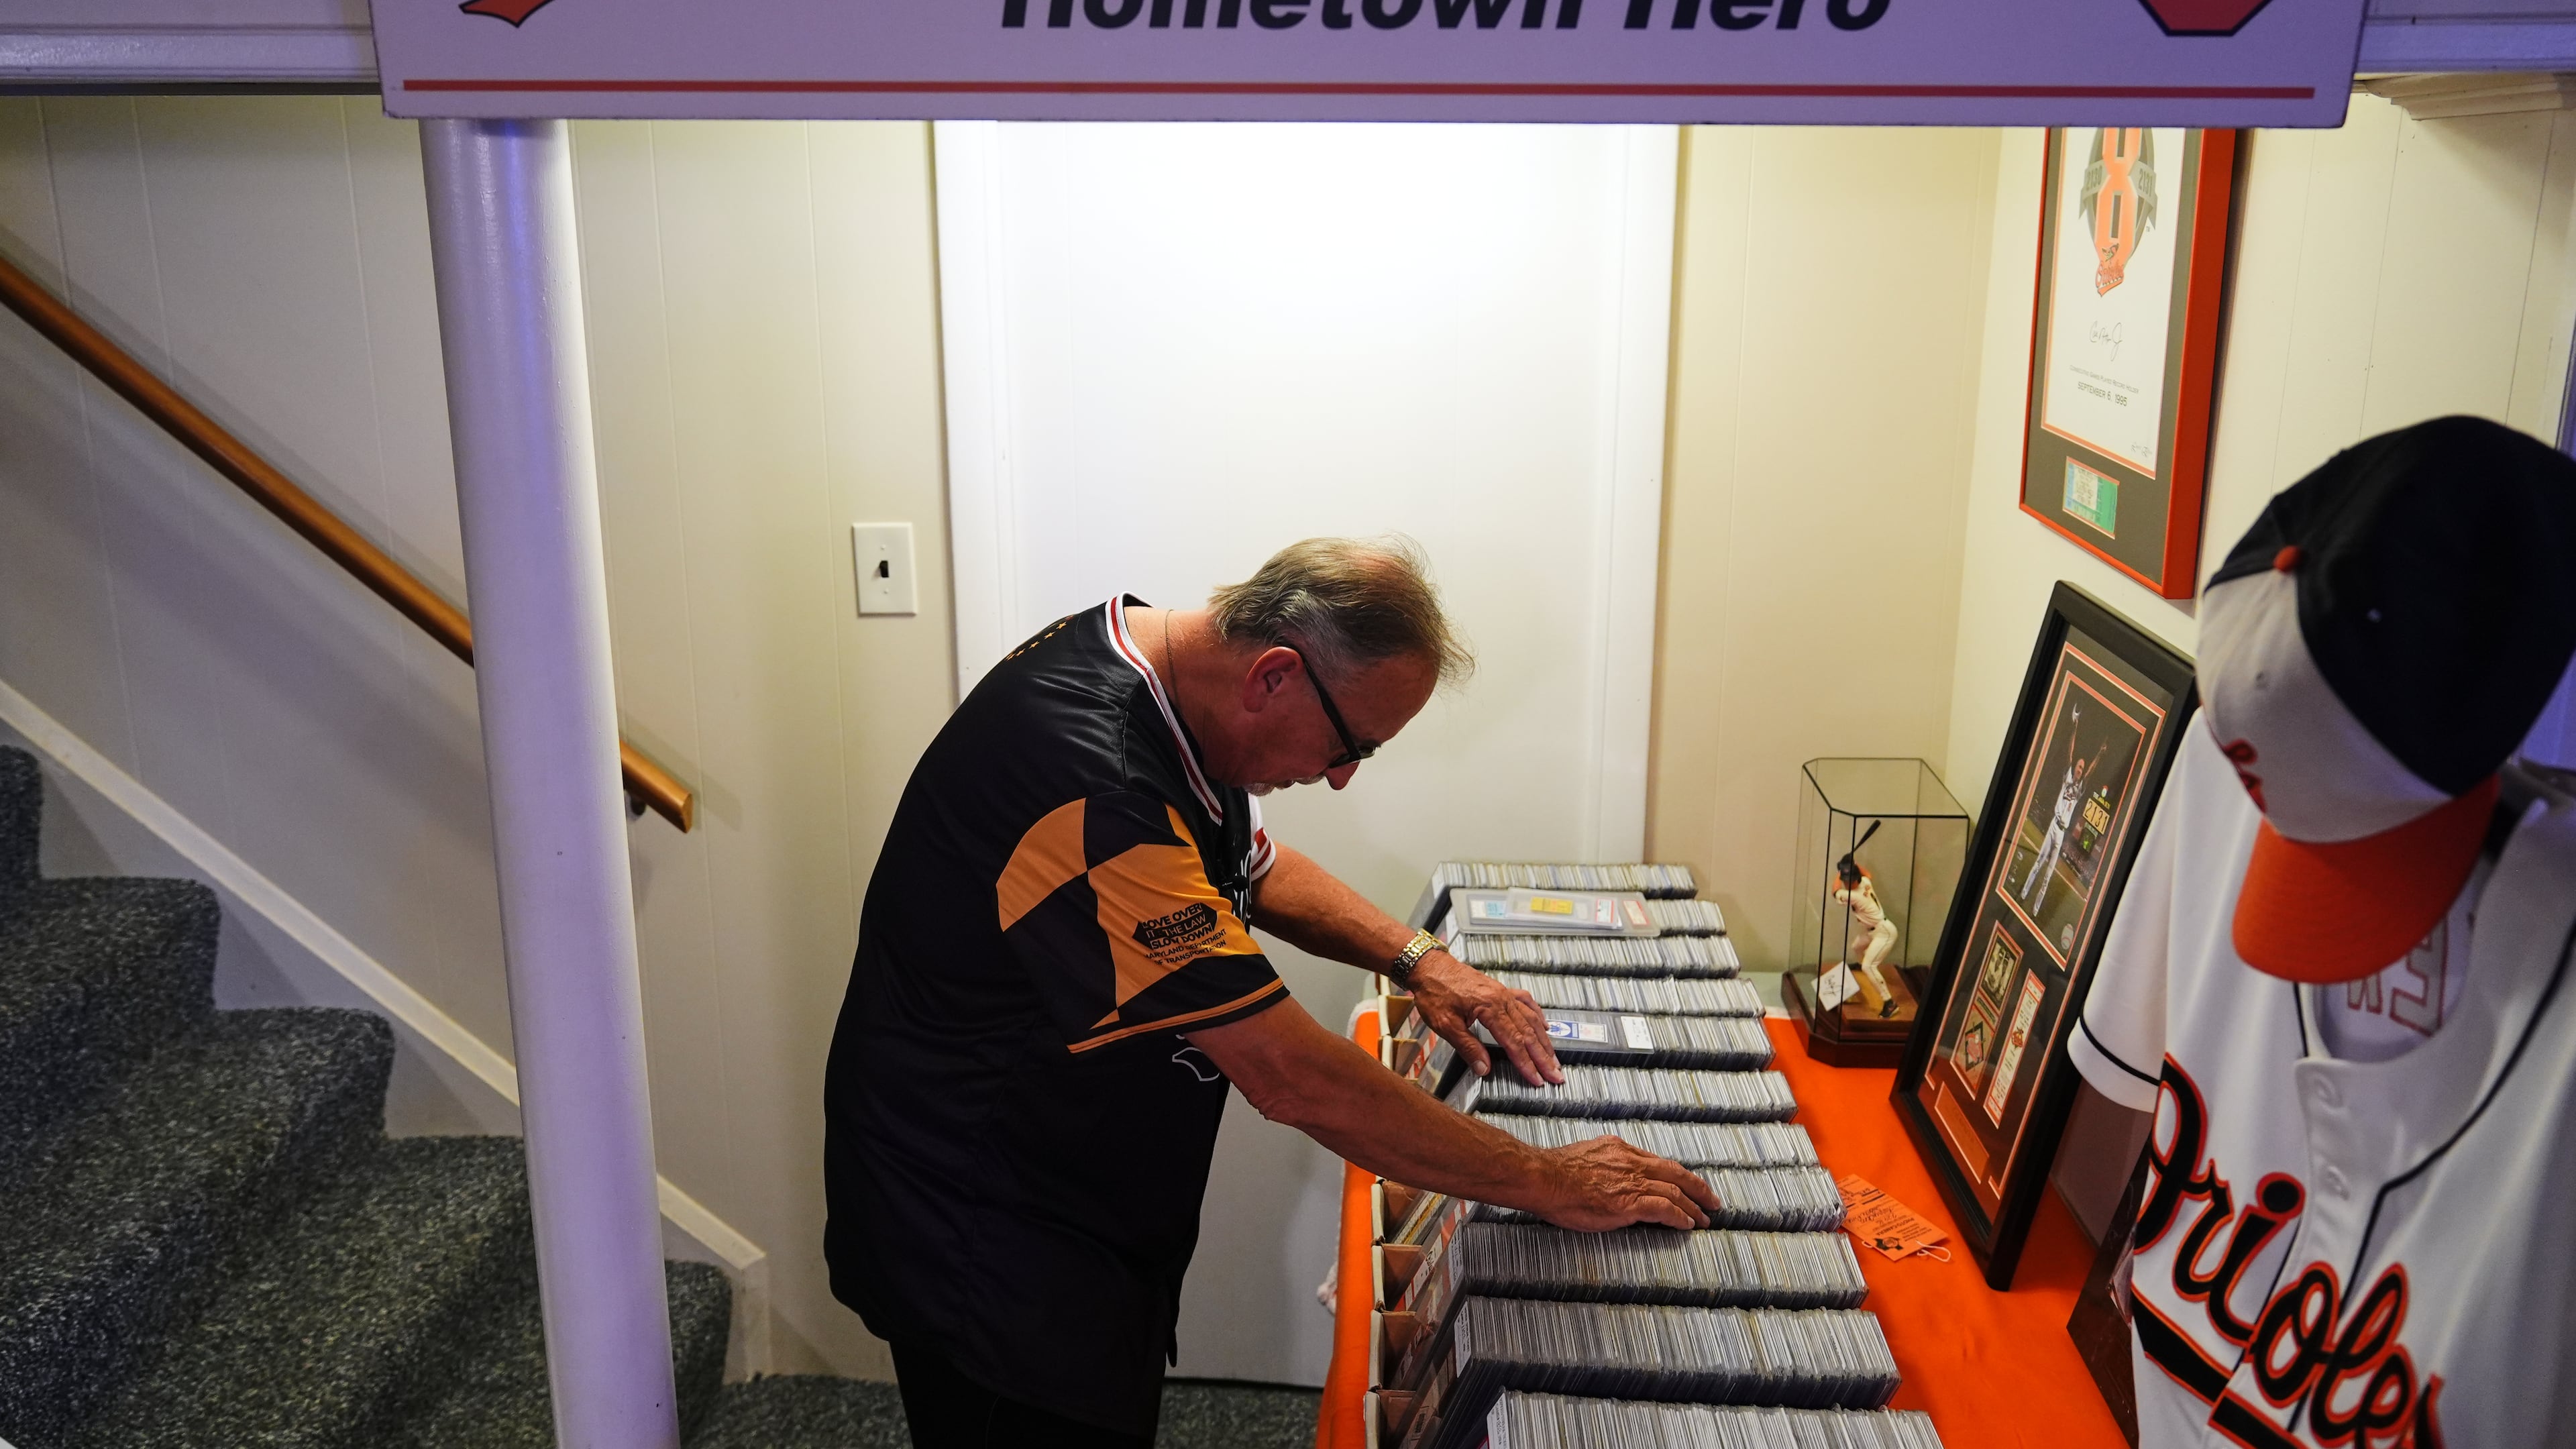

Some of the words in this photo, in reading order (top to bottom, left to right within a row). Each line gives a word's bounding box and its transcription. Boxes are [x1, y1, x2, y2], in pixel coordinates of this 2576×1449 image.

[2138, 168, 2153, 197] 2131
[2078, 381, 2106, 399] SEPTEMBER
[2115, 393, 2127, 407] 1995
[2084, 801, 2108, 833] 2131
[1172, 903, 1203, 921] OVER
[1162, 925, 1183, 936] THE
[1184, 914, 1206, 930] LAW
[1181, 925, 1213, 943] DOWN
[1164, 939, 1226, 963] TRANSPORTAION
